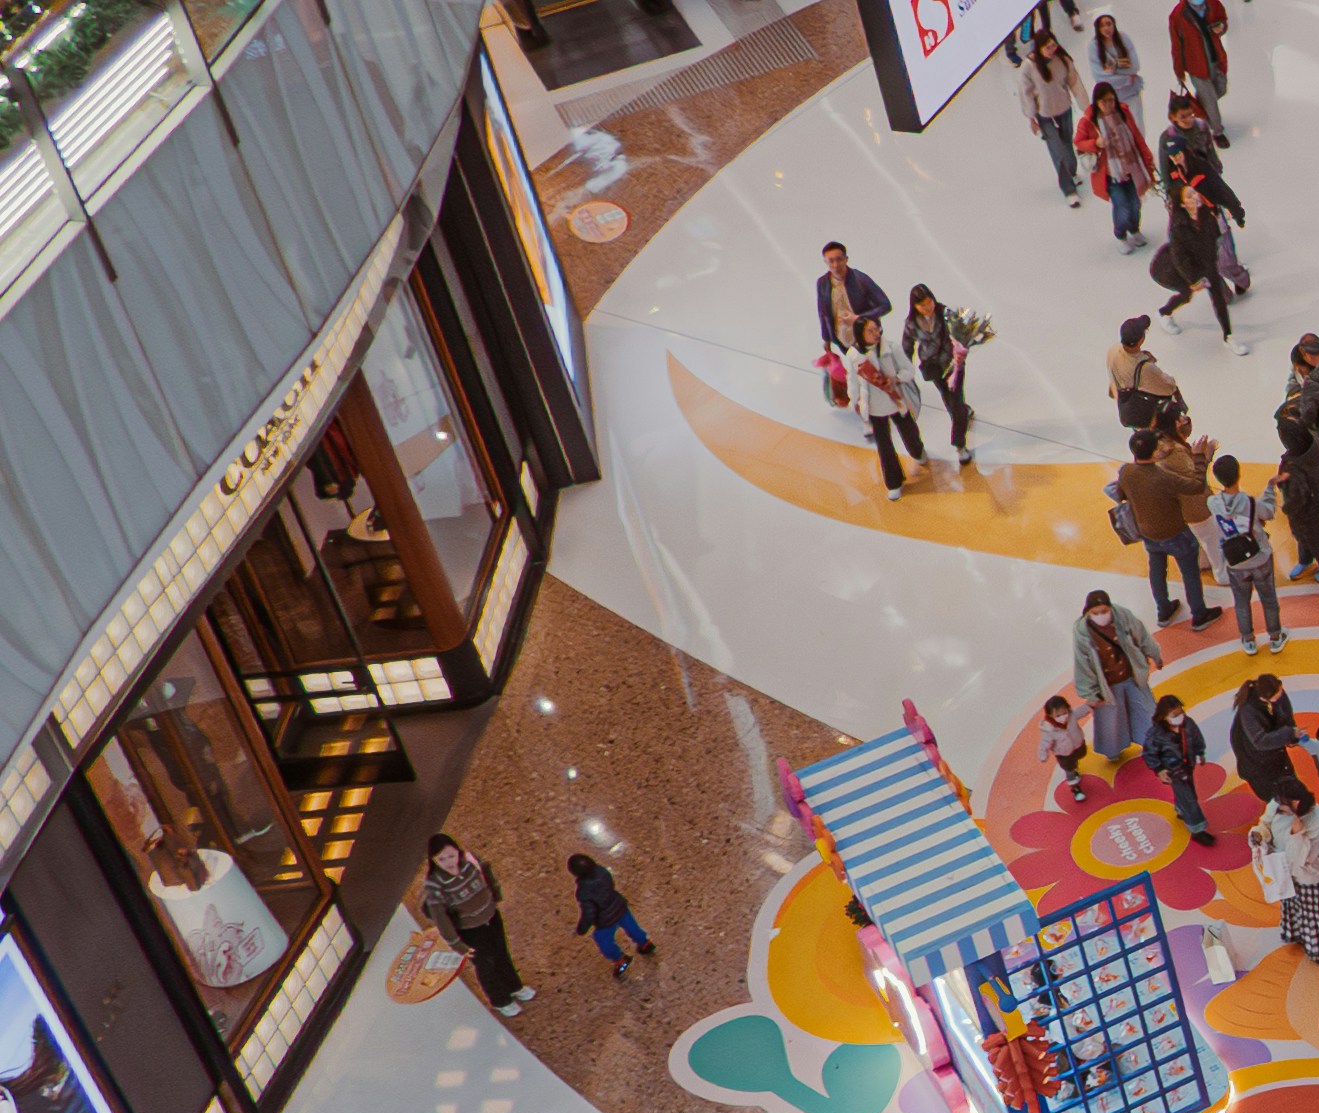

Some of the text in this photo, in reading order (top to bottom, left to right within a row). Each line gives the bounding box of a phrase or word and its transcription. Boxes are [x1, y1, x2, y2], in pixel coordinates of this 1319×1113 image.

[219, 358, 320, 496] COACH
[1107, 823, 1138, 861] cheeky
[1124, 816, 1155, 854] cheeky
